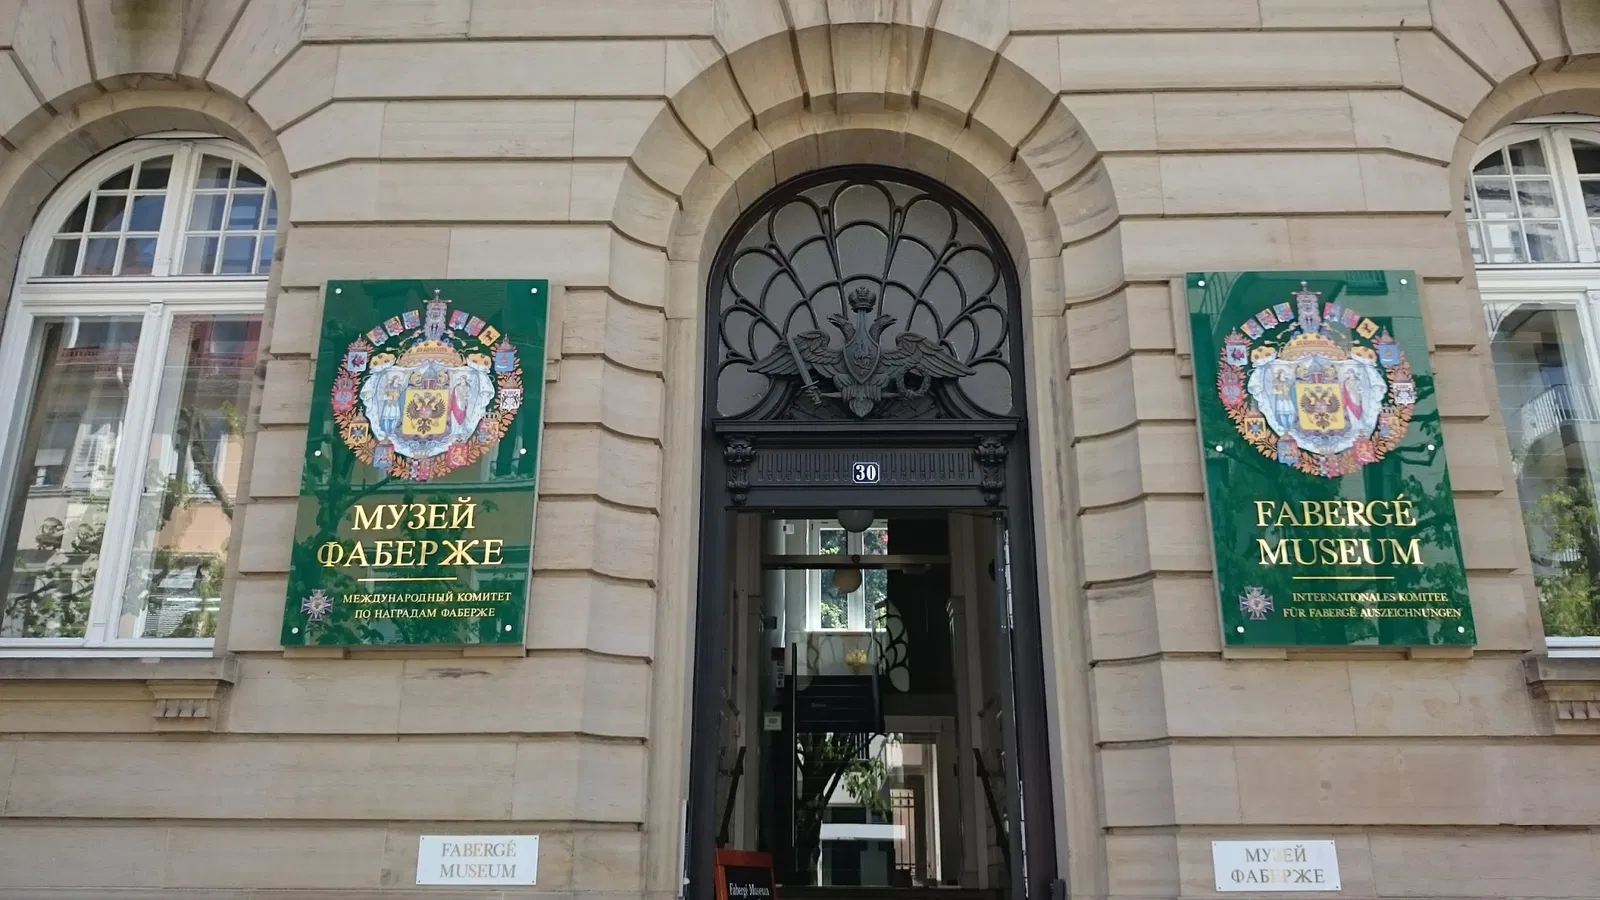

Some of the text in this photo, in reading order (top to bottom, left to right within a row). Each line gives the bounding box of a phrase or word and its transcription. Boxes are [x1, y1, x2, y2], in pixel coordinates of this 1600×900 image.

[855, 464, 877, 481] 30
[351, 496, 477, 530] МУЗЕЙ
[1254, 493, 1417, 527] FABERGÉ
[316, 539, 504, 568] ФАБЕРЖЕ
[1255, 538, 1424, 565] MUSEUM
[342, 591, 512, 604] МЕЖДУНАРОДНЫЙ КОМИТЕТ
[1292, 592, 1449, 602] INTERNATIONALES KOMITEE
[354, 607, 496, 619] ПО НАГРАДАМ ФАБЕРЖЕ
[1283, 606, 1462, 618] FÜR FABERGÉ AUSZEICHNUNGEN
[441, 839, 517, 857] FABERGÉ
[439, 864, 517, 878] MUSEUM
[748, 883, 770, 896] Museum
